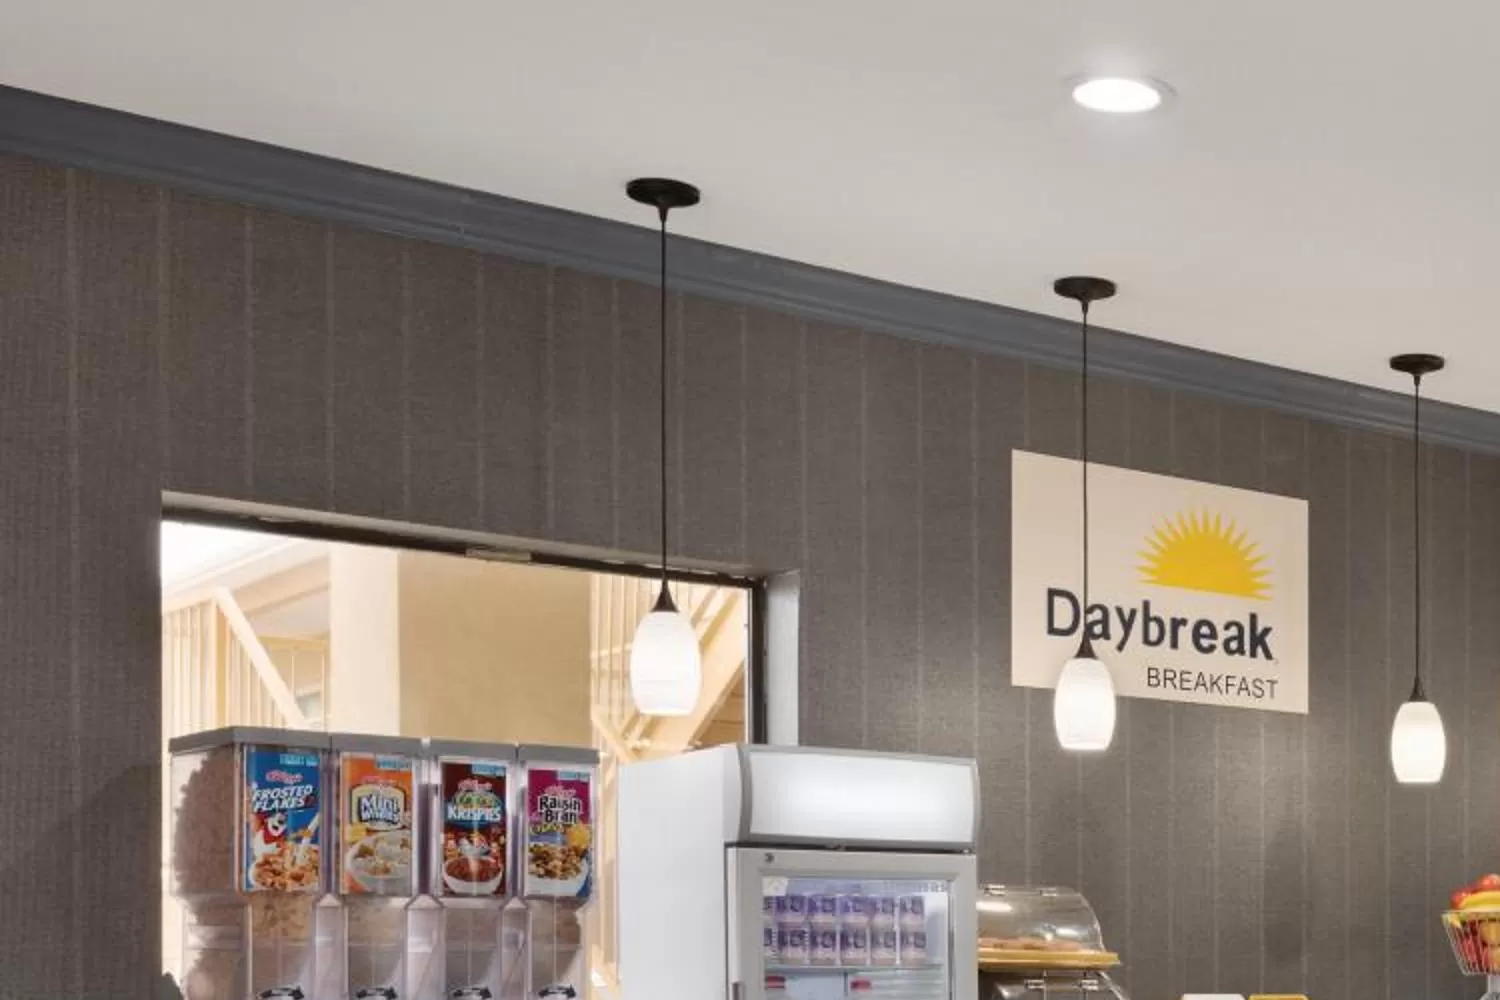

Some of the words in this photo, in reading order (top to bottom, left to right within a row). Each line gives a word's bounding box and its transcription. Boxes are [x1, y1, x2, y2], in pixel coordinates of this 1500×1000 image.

[1046, 587, 1274, 661] Daybreak
[1147, 666, 1279, 699] BREAKFAST
[538, 794, 583, 812] Raisin
[544, 808, 578, 824] Bran
